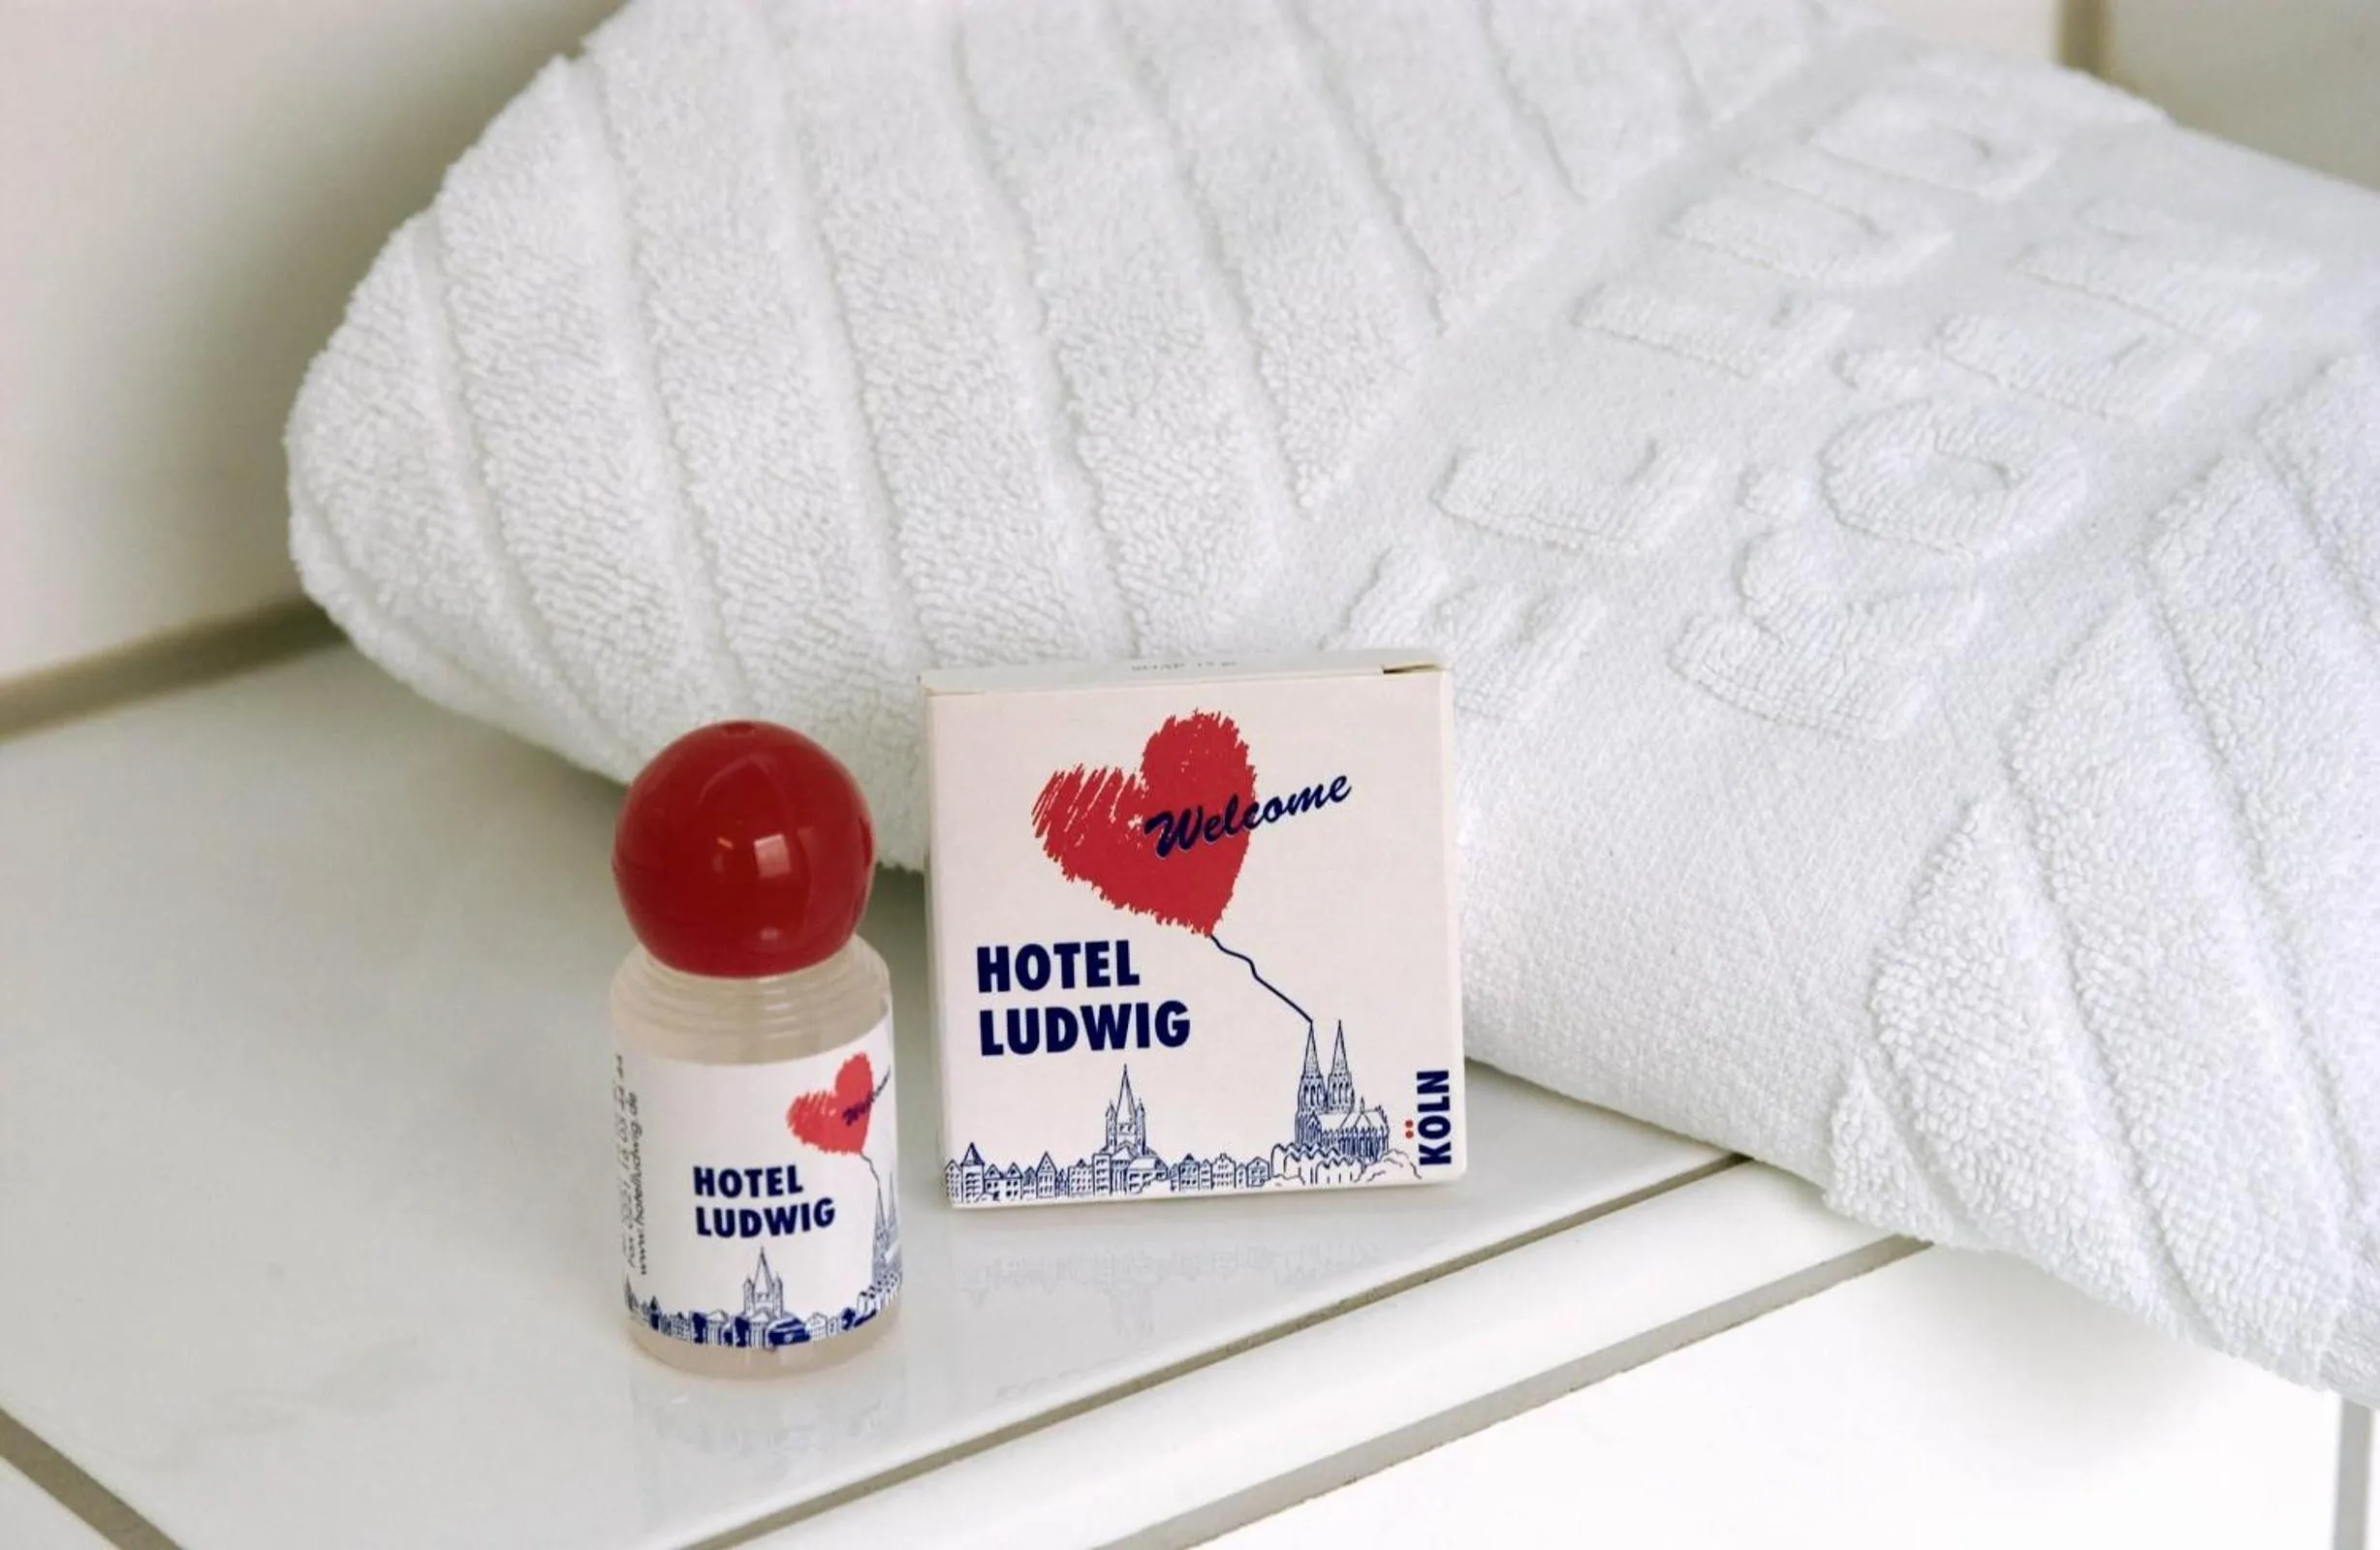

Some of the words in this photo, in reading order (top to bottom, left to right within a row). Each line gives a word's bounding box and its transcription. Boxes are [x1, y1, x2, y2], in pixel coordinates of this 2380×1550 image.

[1143, 775, 1353, 858] Welcome
[976, 939, 1141, 994] HOTEL
[979, 1000, 1191, 1057] LUDWIG
[1403, 1070, 1453, 1165] KÖLN
[693, 1164, 804, 1198] HOTEL
[695, 1197, 836, 1239] LUDWIG
